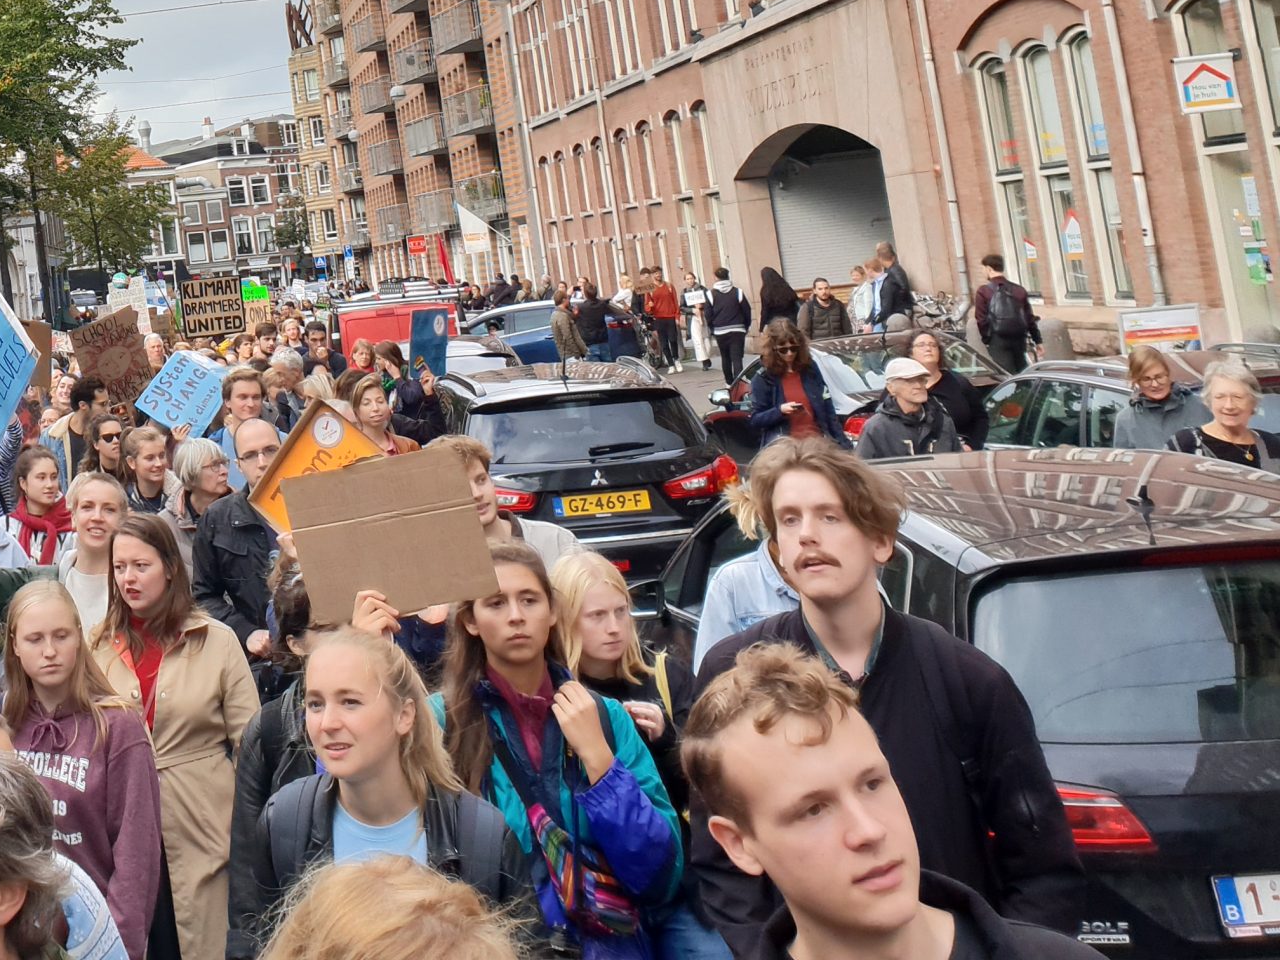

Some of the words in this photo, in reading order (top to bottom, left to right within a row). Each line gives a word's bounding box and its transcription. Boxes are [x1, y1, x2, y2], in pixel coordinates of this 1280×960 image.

[183, 278, 239, 300] KLIMAAT
[185, 298, 241, 317] DRAMMERS
[72, 315, 122, 348] SCHOOL
[187, 315, 243, 334] UNITED
[568, 493, 643, 513] GZ-469-F
[1225, 904, 1241, 921] B
